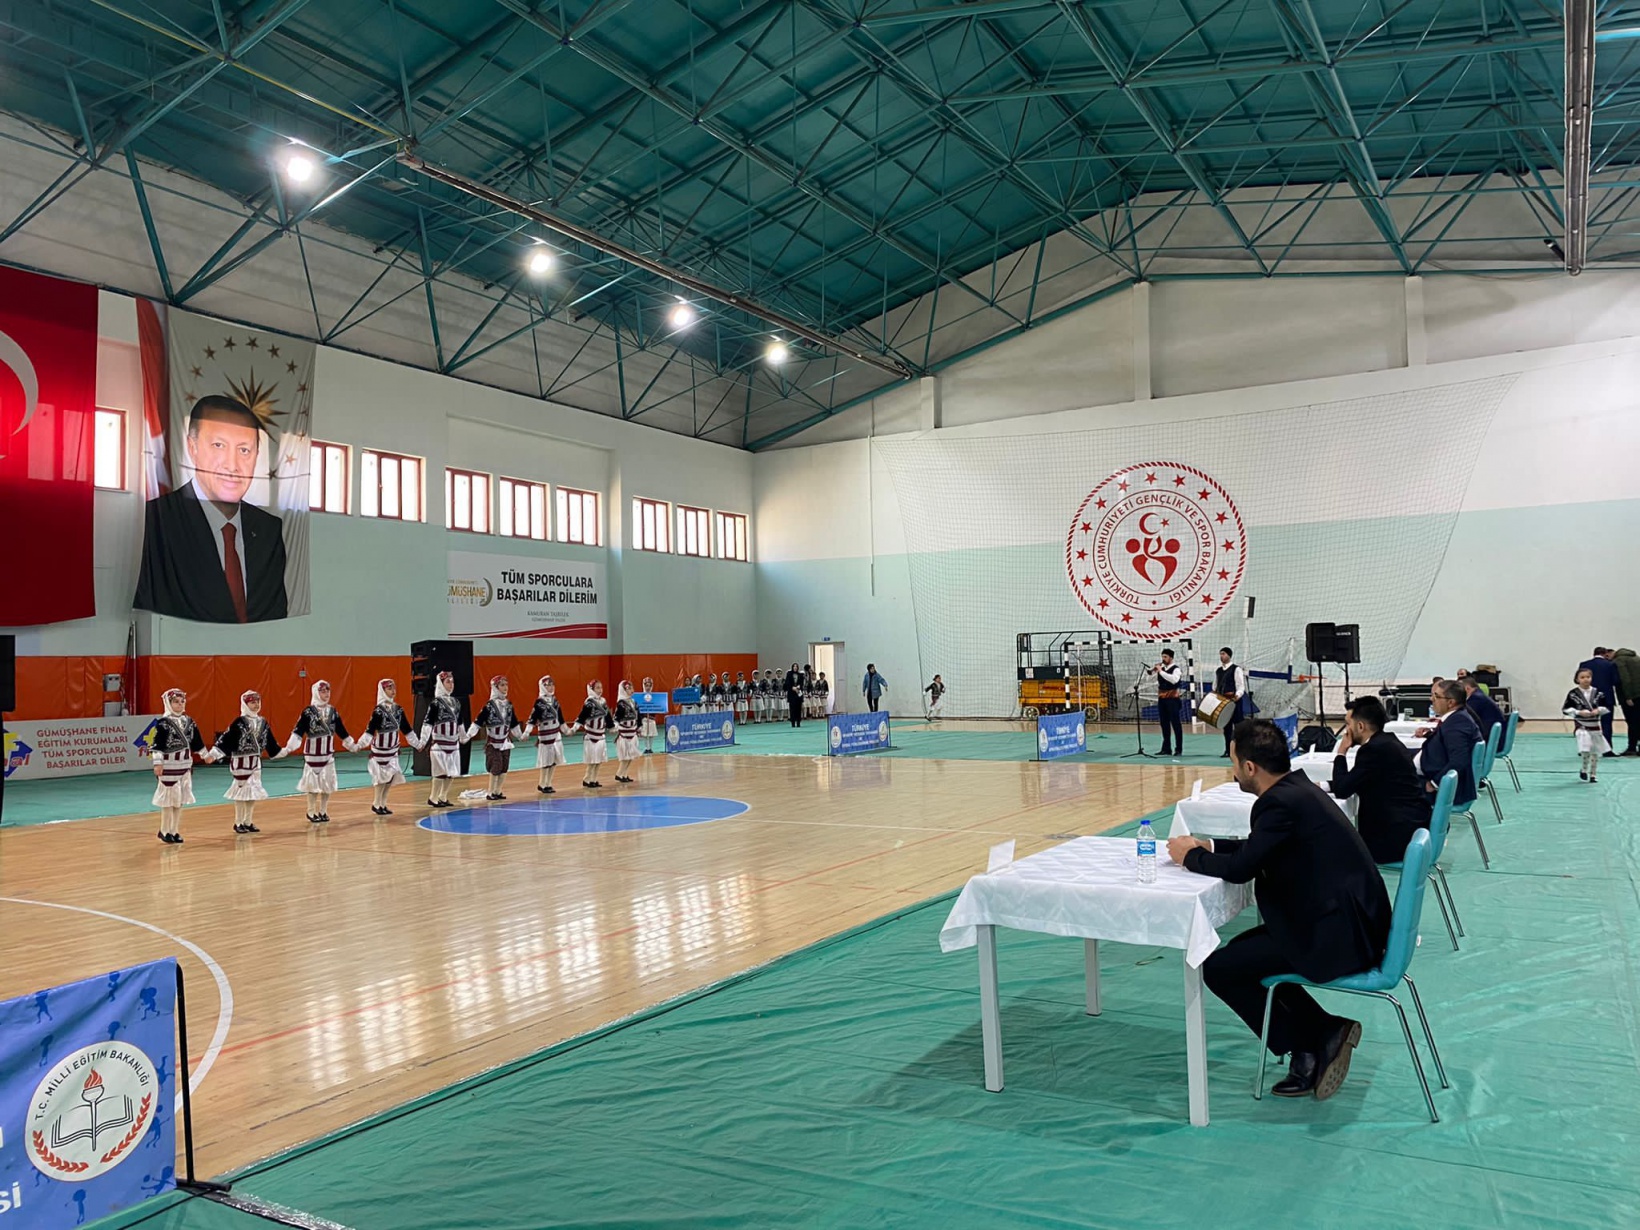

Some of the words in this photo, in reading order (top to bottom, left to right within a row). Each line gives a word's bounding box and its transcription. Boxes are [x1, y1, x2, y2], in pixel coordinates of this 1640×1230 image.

[1135, 494, 1184, 509] GENÇLİK
[1184, 505, 1198, 519] VE
[1098, 499, 1134, 570] CUMHURİYETİ
[1194, 518, 1211, 548] SPOR
[501, 569, 525, 585] TÜM
[528, 573, 593, 589] SPORCULARA
[1102, 571, 1140, 605] TÜRKİYE
[497, 588, 556, 605] BAŞARILAR
[559, 590, 598, 605] DİLERİM
[37, 727, 98, 738] GÜMÜŞHANE
[100, 725, 127, 734] FİNAL
[74, 736, 128, 746] KURUMLARI
[42, 749, 64, 758] TÜM
[66, 746, 127, 757] SPORCULARA
[46, 759, 97, 769] BAŞARILAR
[100, 756, 126, 765] DİLER
[35, 1099, 50, 1120] T.C.
[45, 1066, 72, 1096] MİLLİ
[72, 1049, 108, 1069] EĞİTİM
[109, 1050, 149, 1086] BAKANLIĞI
